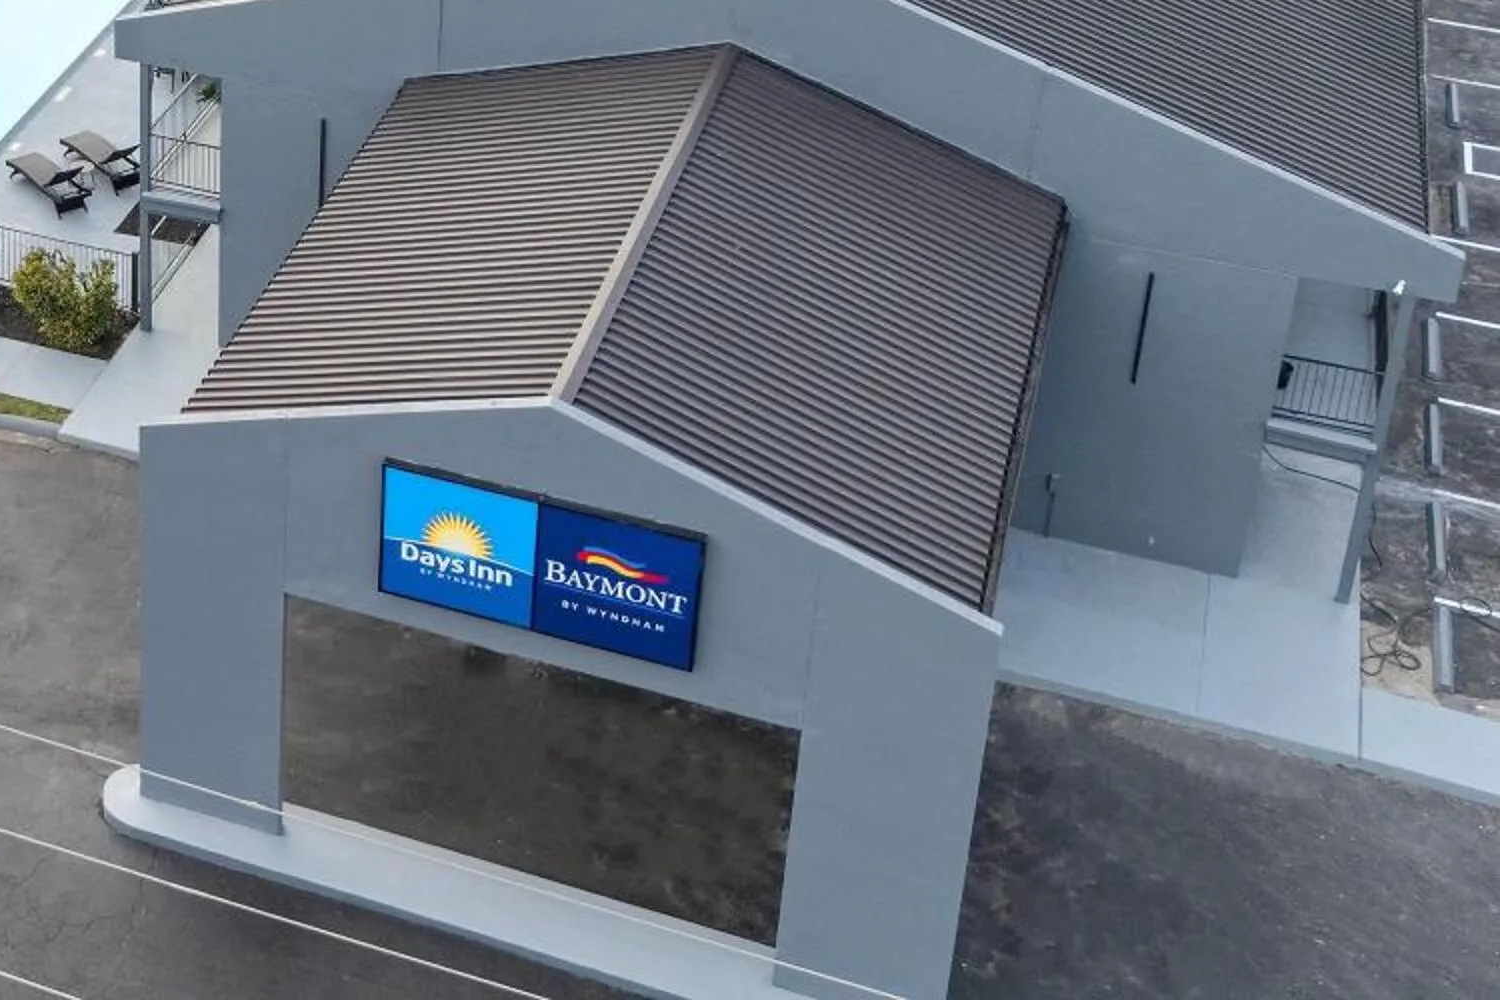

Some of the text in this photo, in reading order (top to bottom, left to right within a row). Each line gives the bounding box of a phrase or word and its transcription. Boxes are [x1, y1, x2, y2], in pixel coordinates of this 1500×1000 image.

[401, 541, 514, 587] Days Inn
[437, 571, 493, 591] WYNDHAM
[544, 559, 688, 615] BAYMONT
[561, 599, 665, 633] BY WYNDHAM
